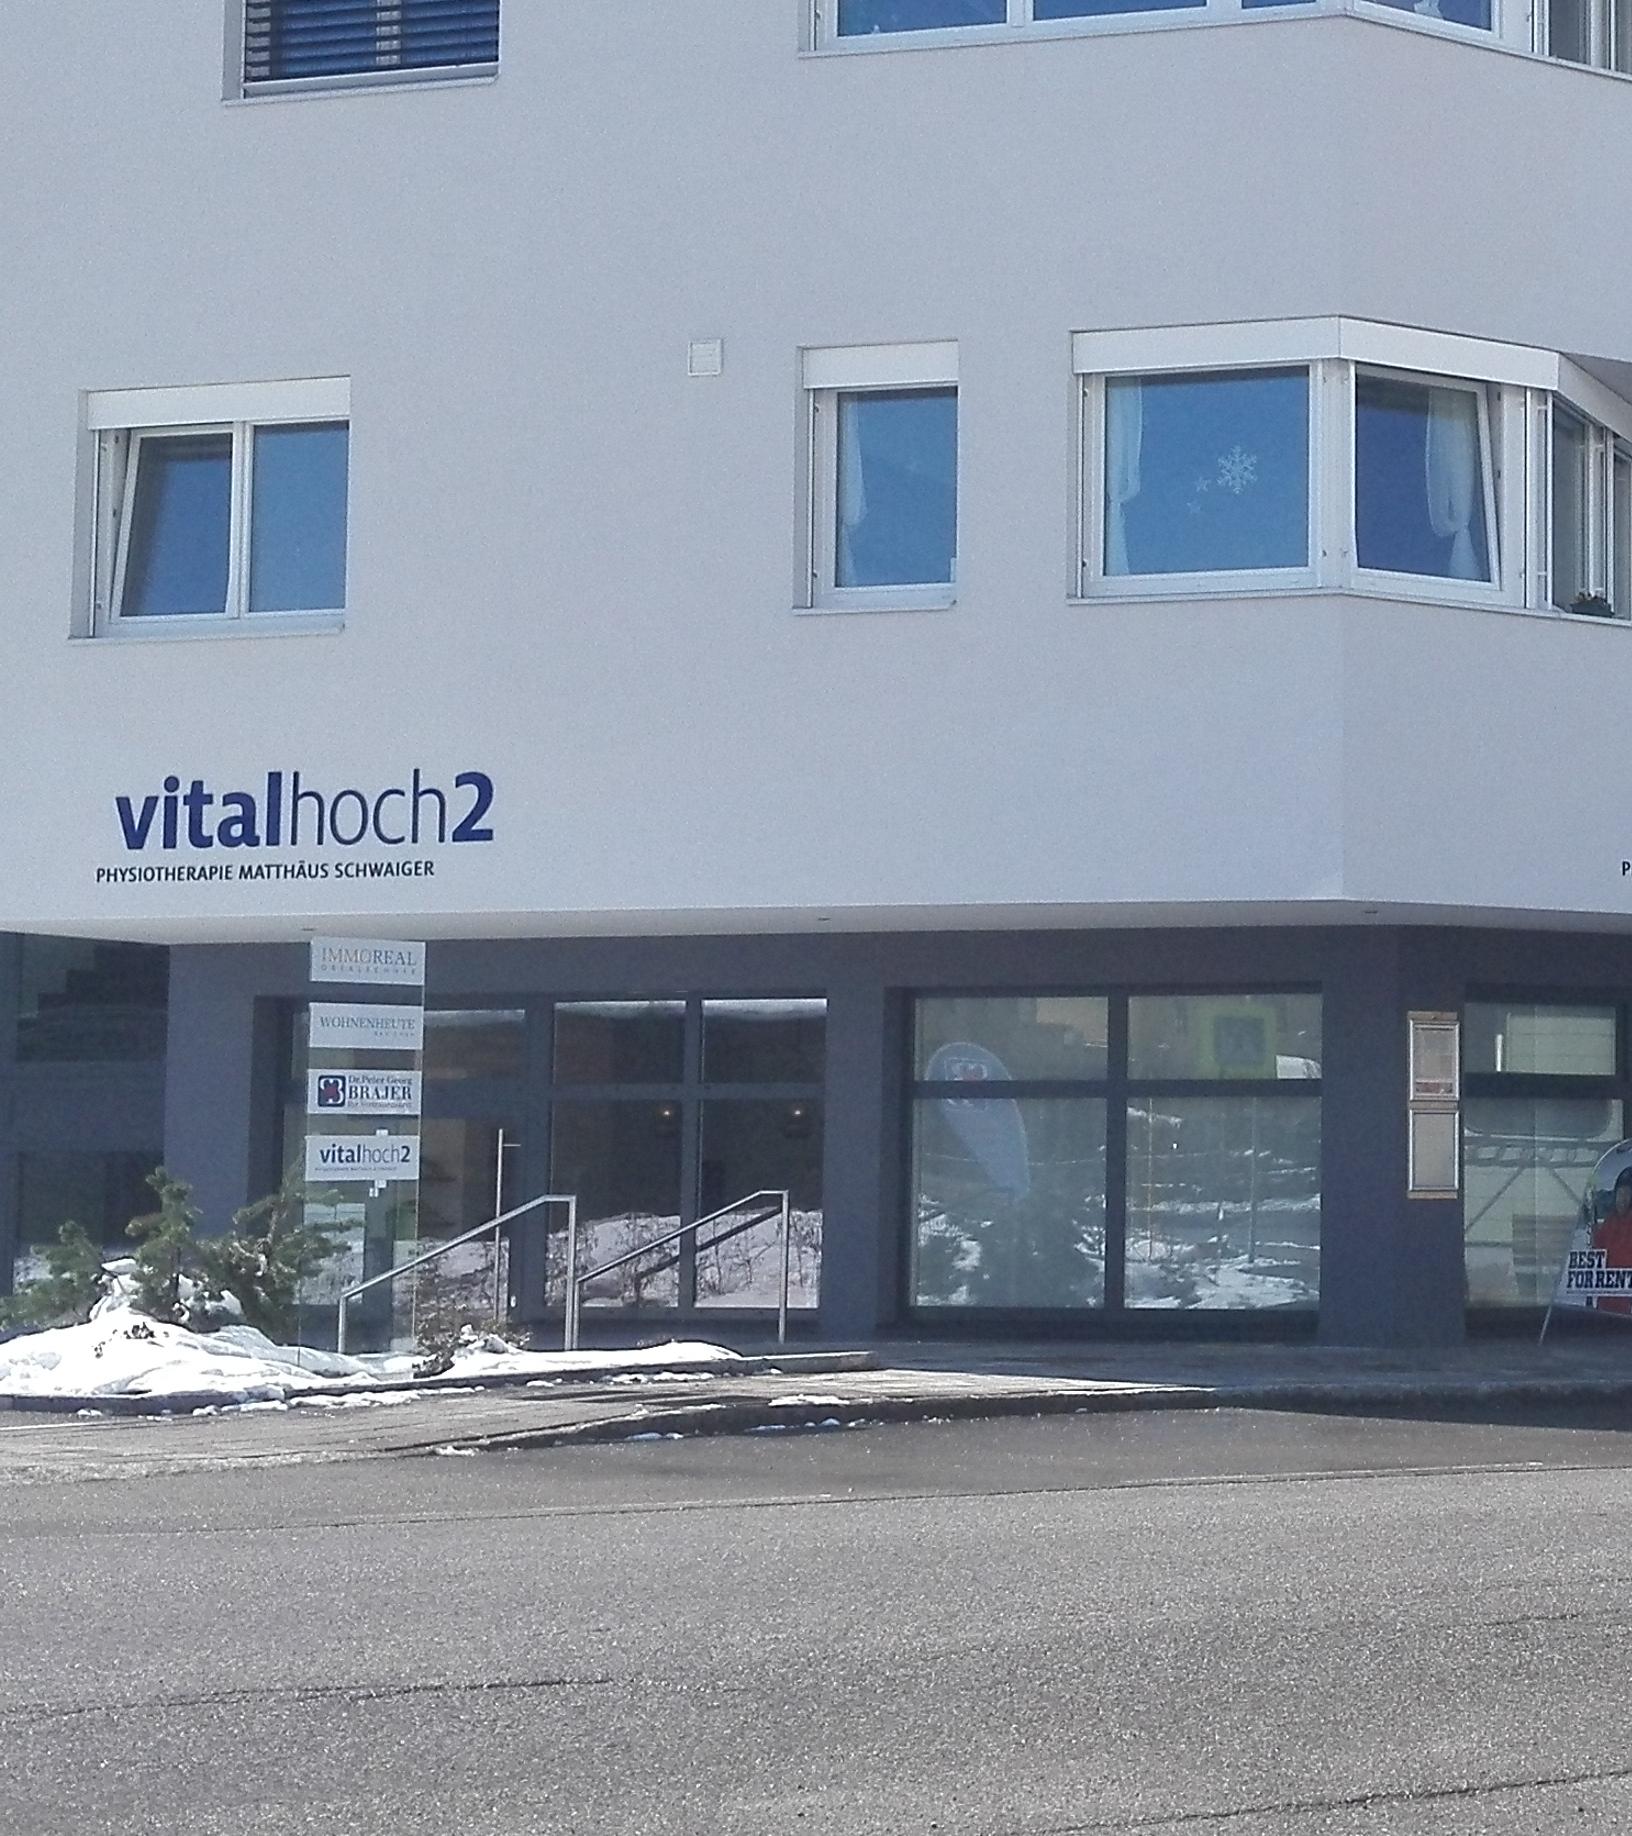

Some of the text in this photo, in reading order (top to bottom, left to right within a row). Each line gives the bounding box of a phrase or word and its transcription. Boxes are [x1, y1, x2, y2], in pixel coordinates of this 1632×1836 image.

[115, 769, 494, 850] vitalhoch2
[96, 861, 434, 883] PHYSIOTHERAPIE MATTHÄUS SCHWAIGER
[321, 948, 417, 966] IMMOREAL
[320, 1016, 415, 1030] WOHNENHEUTE
[349, 1085, 412, 1100] BRAJER
[320, 1143, 410, 1163] vitalhoch2
[1568, 1251, 1605, 1269] BEST
[1567, 1270, 1593, 1288] FOR
